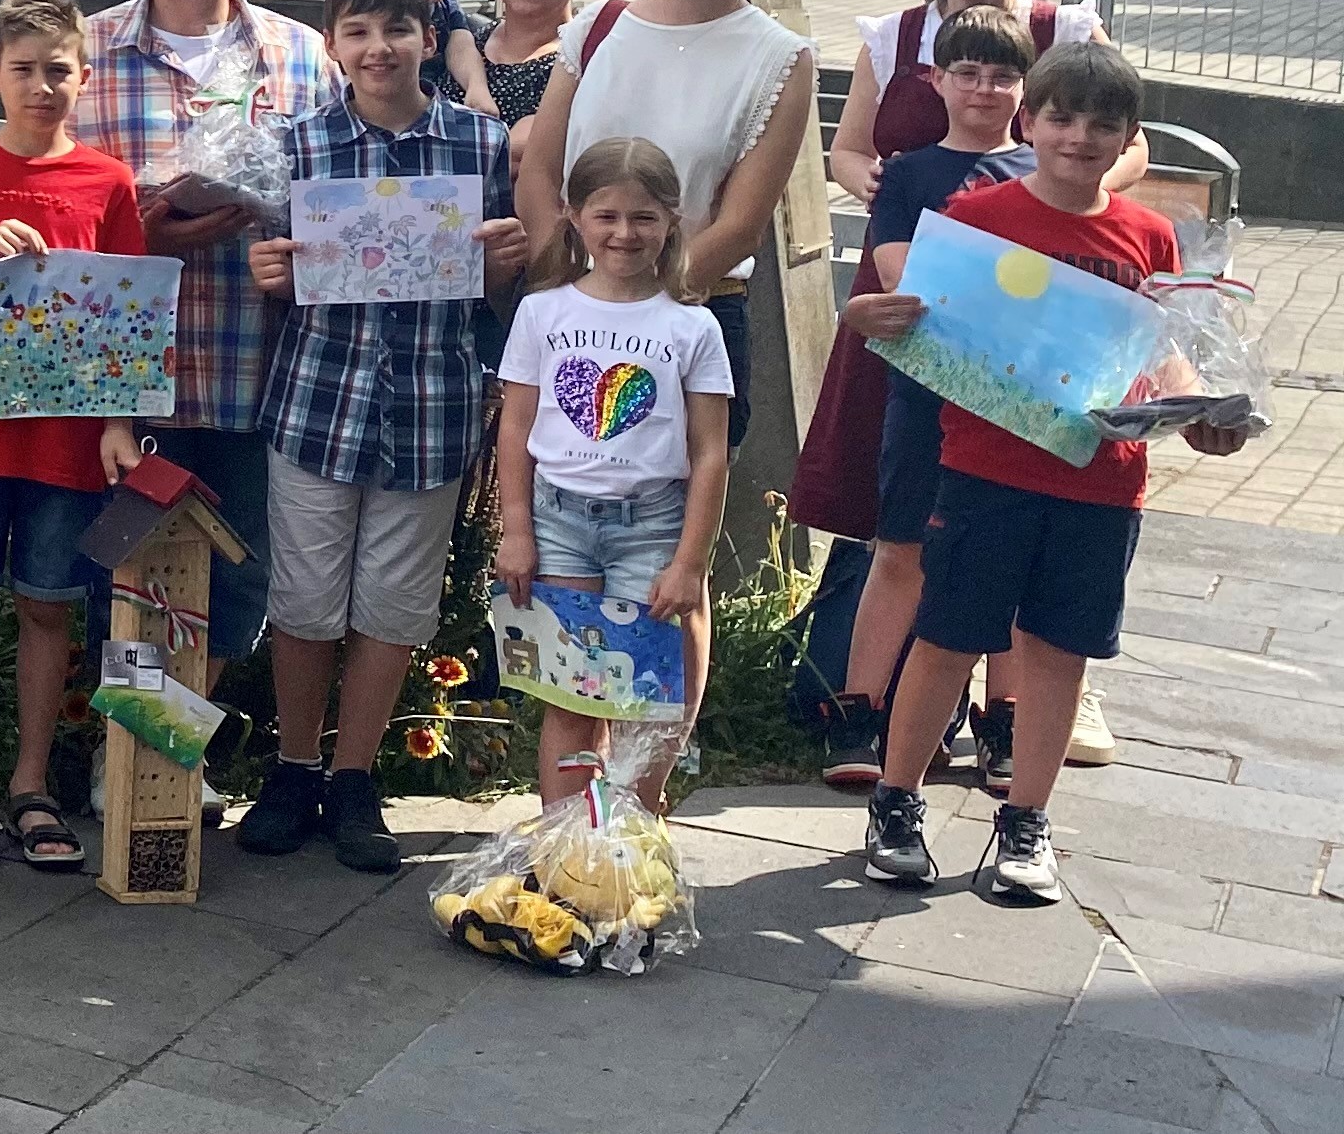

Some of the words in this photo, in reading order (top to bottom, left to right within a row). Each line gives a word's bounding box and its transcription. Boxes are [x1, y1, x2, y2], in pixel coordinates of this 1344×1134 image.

[546, 329, 675, 364] FABULOUS
[577, 451, 605, 461] EVERY
[610, 456, 630, 465] WAY
